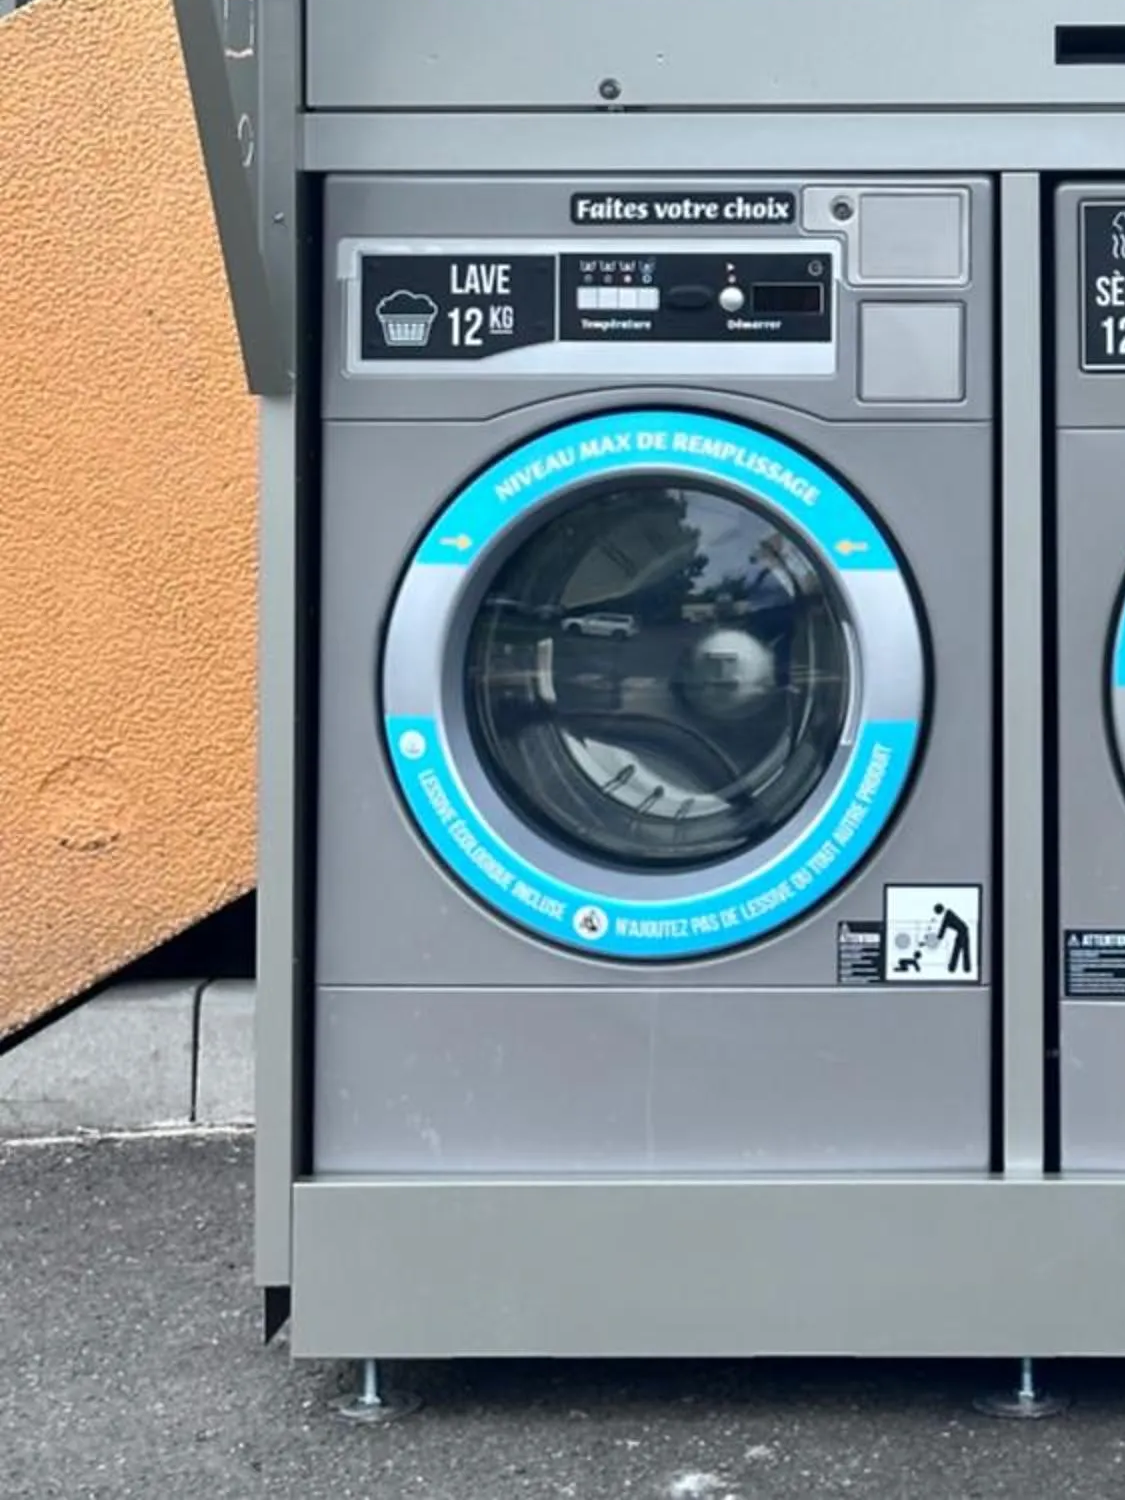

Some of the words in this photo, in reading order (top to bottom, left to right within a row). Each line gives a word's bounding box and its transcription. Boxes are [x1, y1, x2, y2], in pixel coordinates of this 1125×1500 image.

[577, 198, 650, 221] Faites
[654, 202, 719, 221] votre
[723, 198, 790, 221] choix
[450, 264, 511, 294] LAVE
[447, 308, 483, 346] 12
[489, 307, 514, 333] KG
[494, 449, 576, 502] NIVEAU
[579, 432, 632, 461] MAX
[636, 432, 668, 451] DE
[672, 431, 822, 506] REMPLISSAGE
